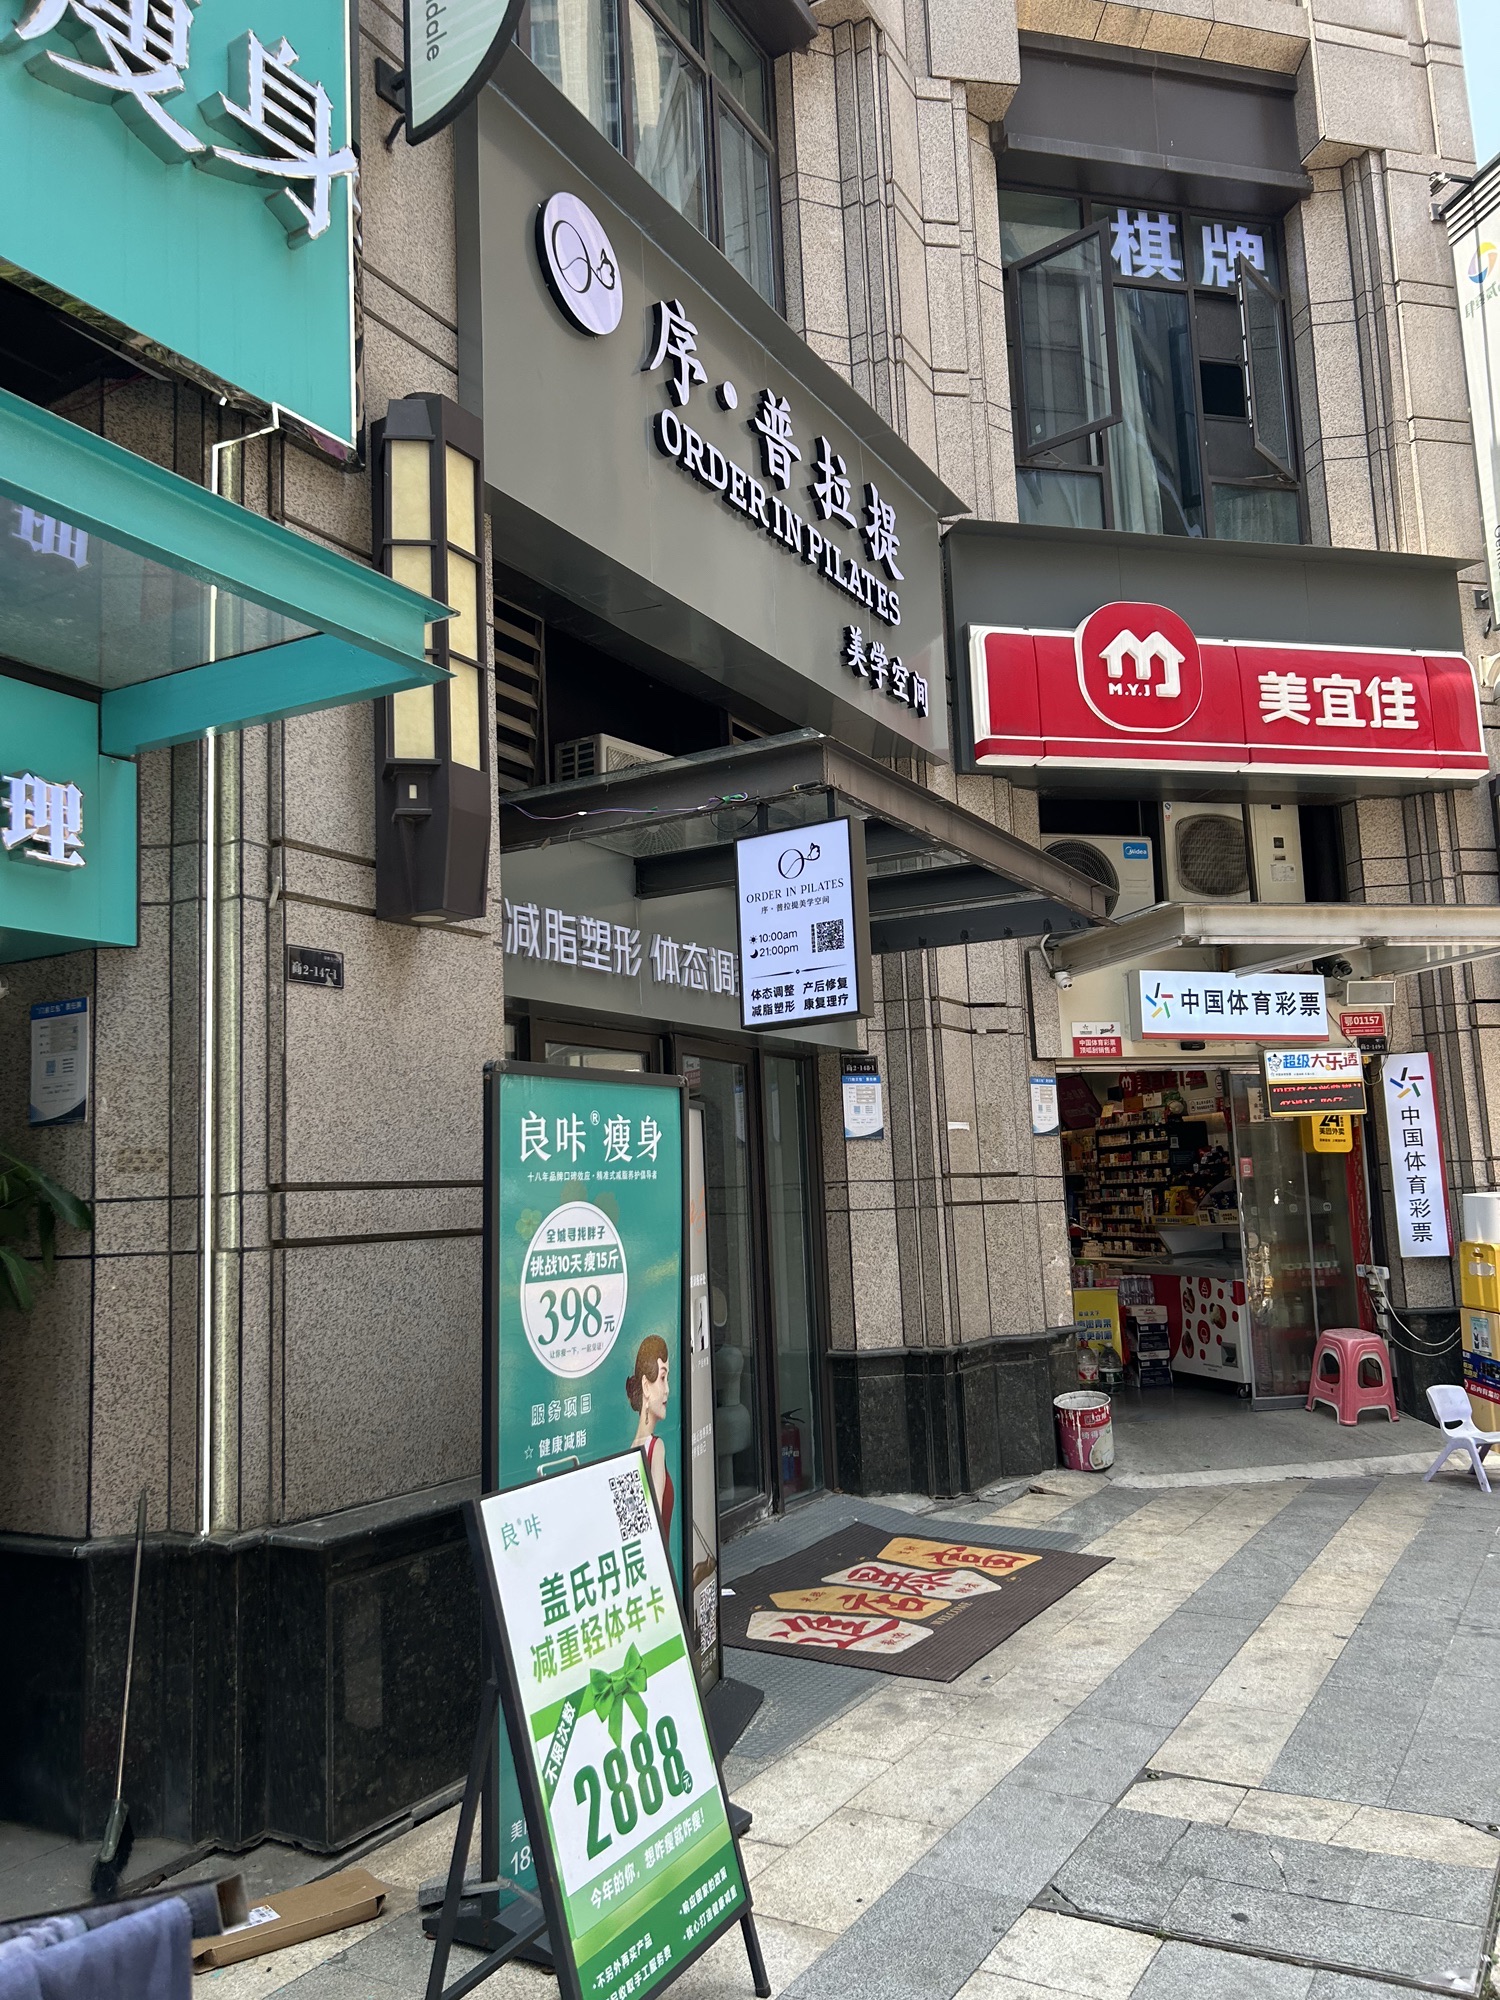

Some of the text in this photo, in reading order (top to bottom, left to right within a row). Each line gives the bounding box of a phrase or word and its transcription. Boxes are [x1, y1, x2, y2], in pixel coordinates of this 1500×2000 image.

[425, 0, 447, 62] dale
[1111, 207, 1267, 288] 棋牌
[659, 409, 902, 627] ORDER IN PILATES
[845, 624, 929, 718] 美学空间
[1258, 671, 1419, 730] 美宜佳
[2, 773, 87, 870] 理
[746, 878, 844, 904] ORDER IN PILATES
[760, 895, 830, 915] 序·普拉提美学空间
[503, 897, 741, 998] 减脂塑形 体态调
[758, 930, 798, 944] 10:00am
[759, 944, 799, 958] 21:00pm
[750, 976, 849, 1001] 体态调整 产后修复
[1180, 988, 1321, 1018] 中国体育彩票
[751, 993, 849, 1017] 减脂塑形 康复理疗
[1344, 1016, 1380, 1027] 鄂01157
[1079, 1039, 1116, 1047] 中国体育彩票
[1282, 1051, 1360, 1071] 超级大乐透
[1399, 1105, 1434, 1243] 中国体育彩票
[546, 1225, 606, 1244] 全城寻找胖子
[530, 1248, 619, 1278] 挑战10天 瘦15斤
[531, 1393, 592, 1427] 服务项目
[539, 1429, 588, 1459] 健康减脂
[538, 1537, 648, 1628] 盖氏丹辰
[530, 1585, 666, 1685] 减重轻体年卡
[544, 1700, 578, 1787] 不限次数
[510, 1845, 535, 1876] 18
